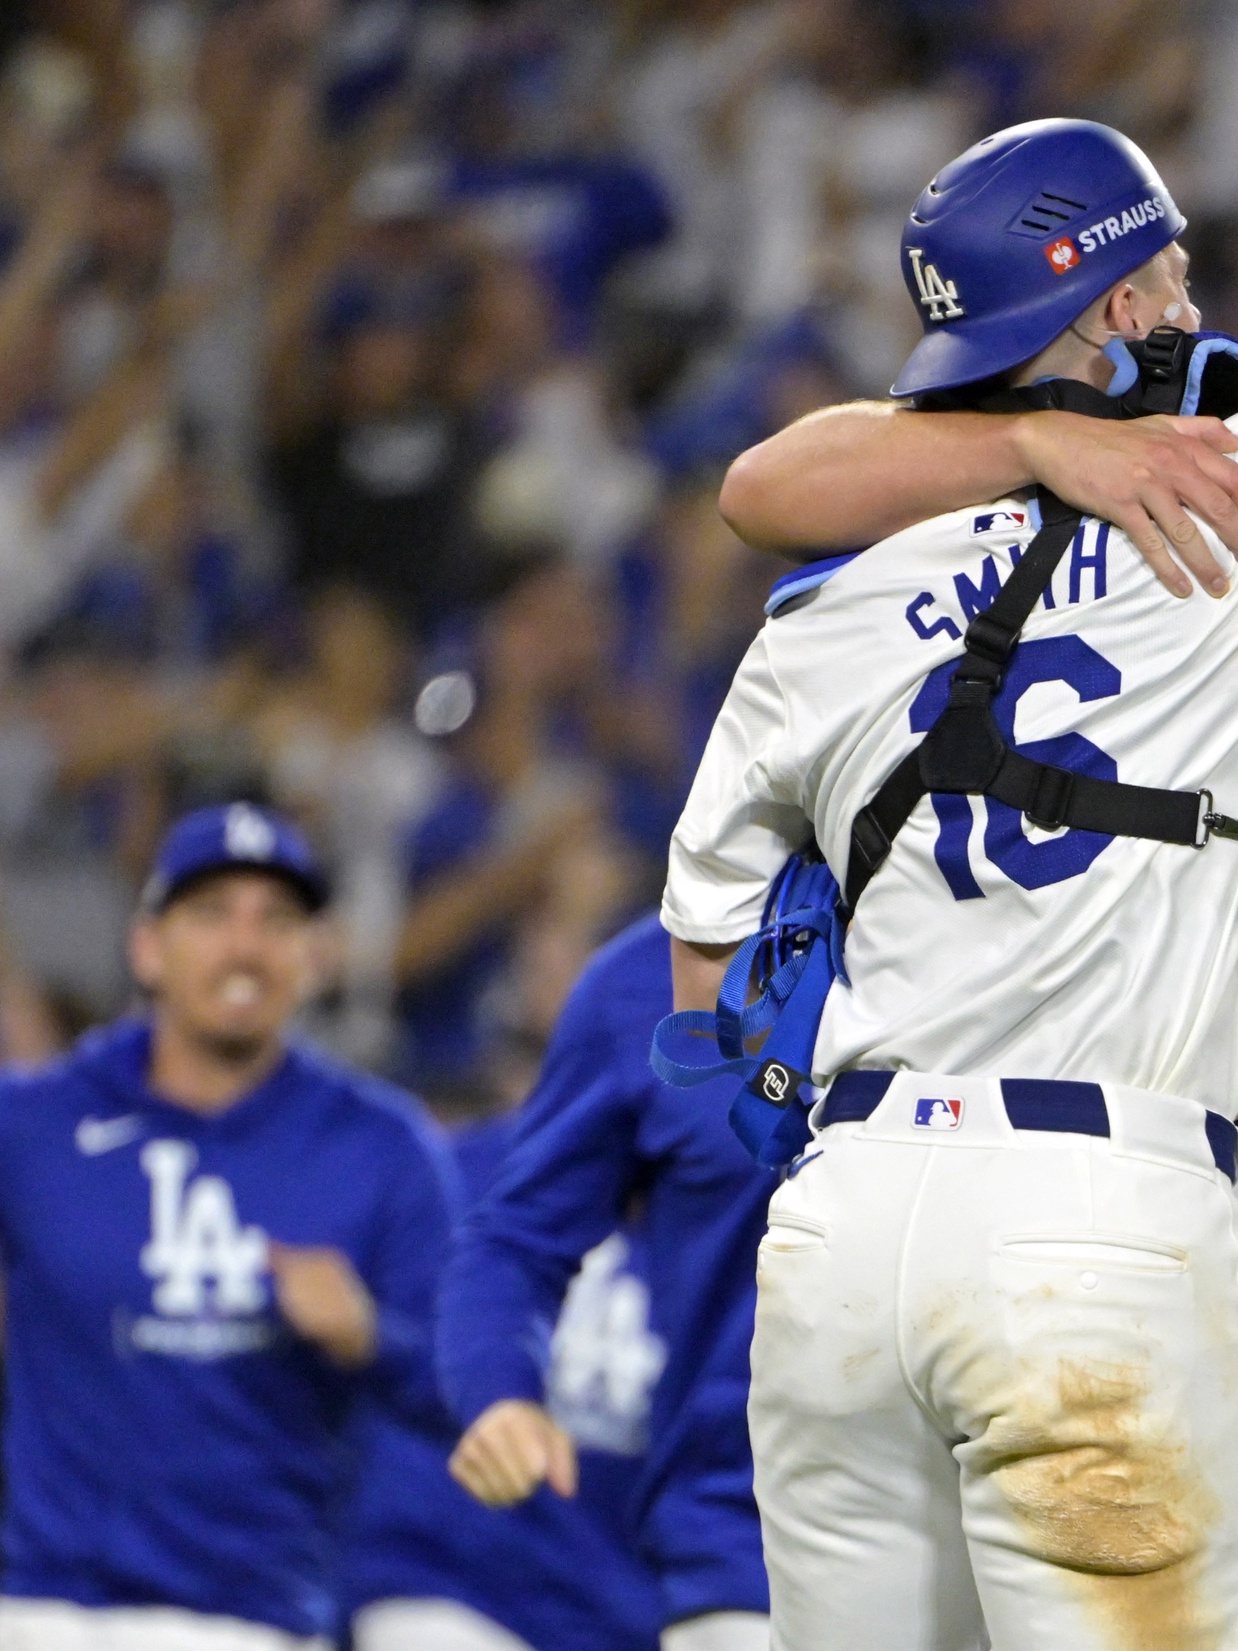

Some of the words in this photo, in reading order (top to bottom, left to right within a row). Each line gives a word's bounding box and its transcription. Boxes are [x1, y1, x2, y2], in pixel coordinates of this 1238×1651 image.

[908, 249, 964, 320] LA
[1078, 197, 1165, 253] STRAUSS
[905, 522, 1111, 641] SMH
[908, 634, 1122, 901] 16
[140, 1138, 268, 1315] LA
